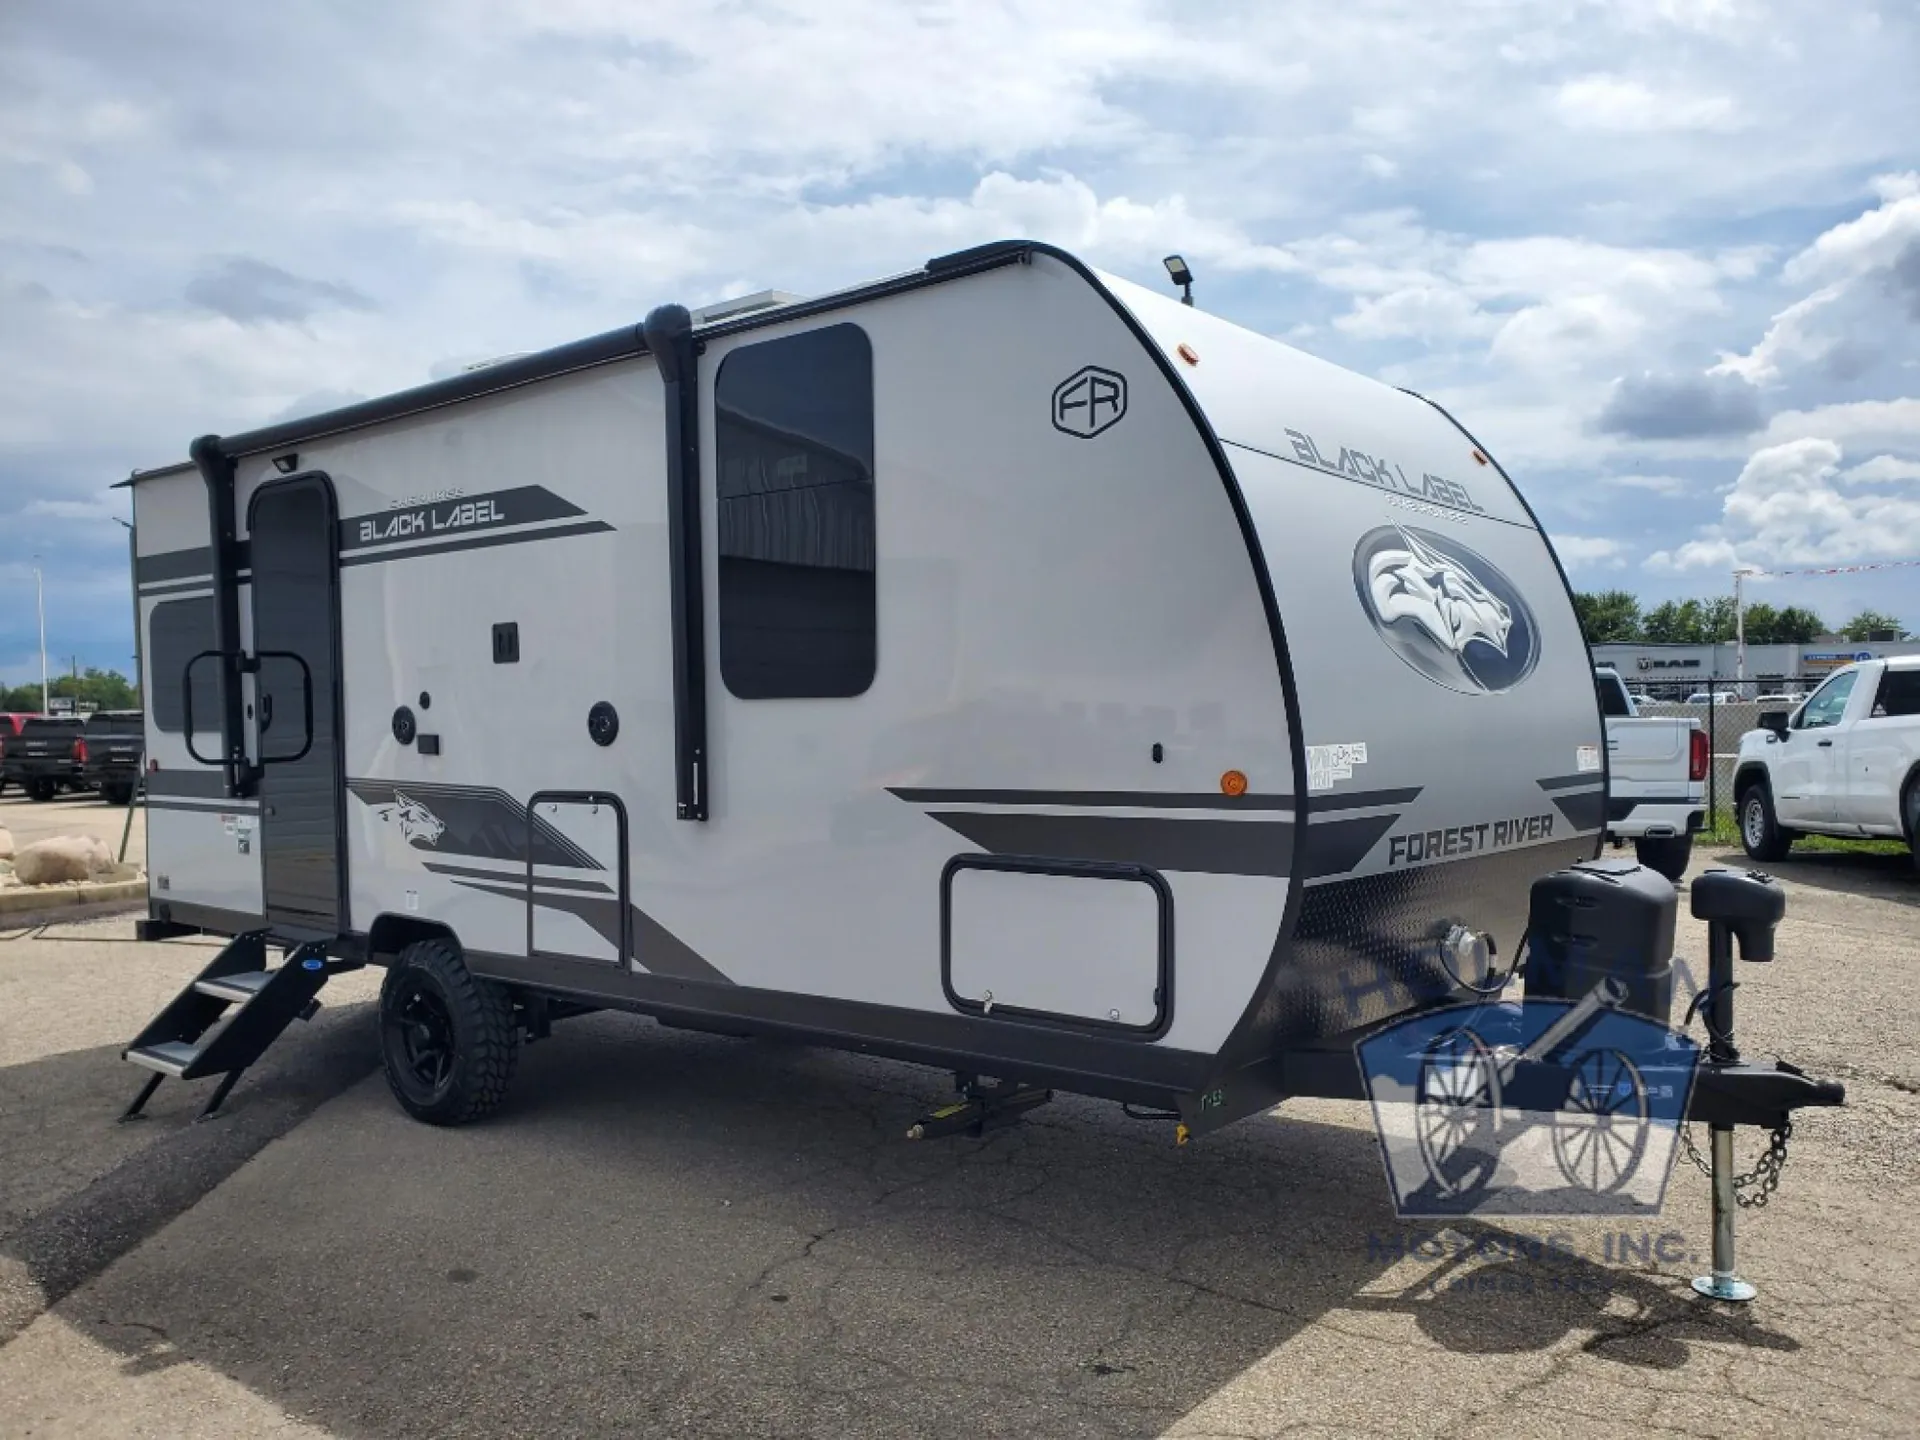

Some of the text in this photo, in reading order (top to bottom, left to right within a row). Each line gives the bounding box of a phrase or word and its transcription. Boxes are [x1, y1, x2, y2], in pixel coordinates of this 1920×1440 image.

[1283, 427, 1398, 488] BLACK
[1394, 463, 1486, 512] LABEL
[359, 499, 505, 542] BLACK LABEL
[1388, 813, 1554, 866] FOREST RIVER
